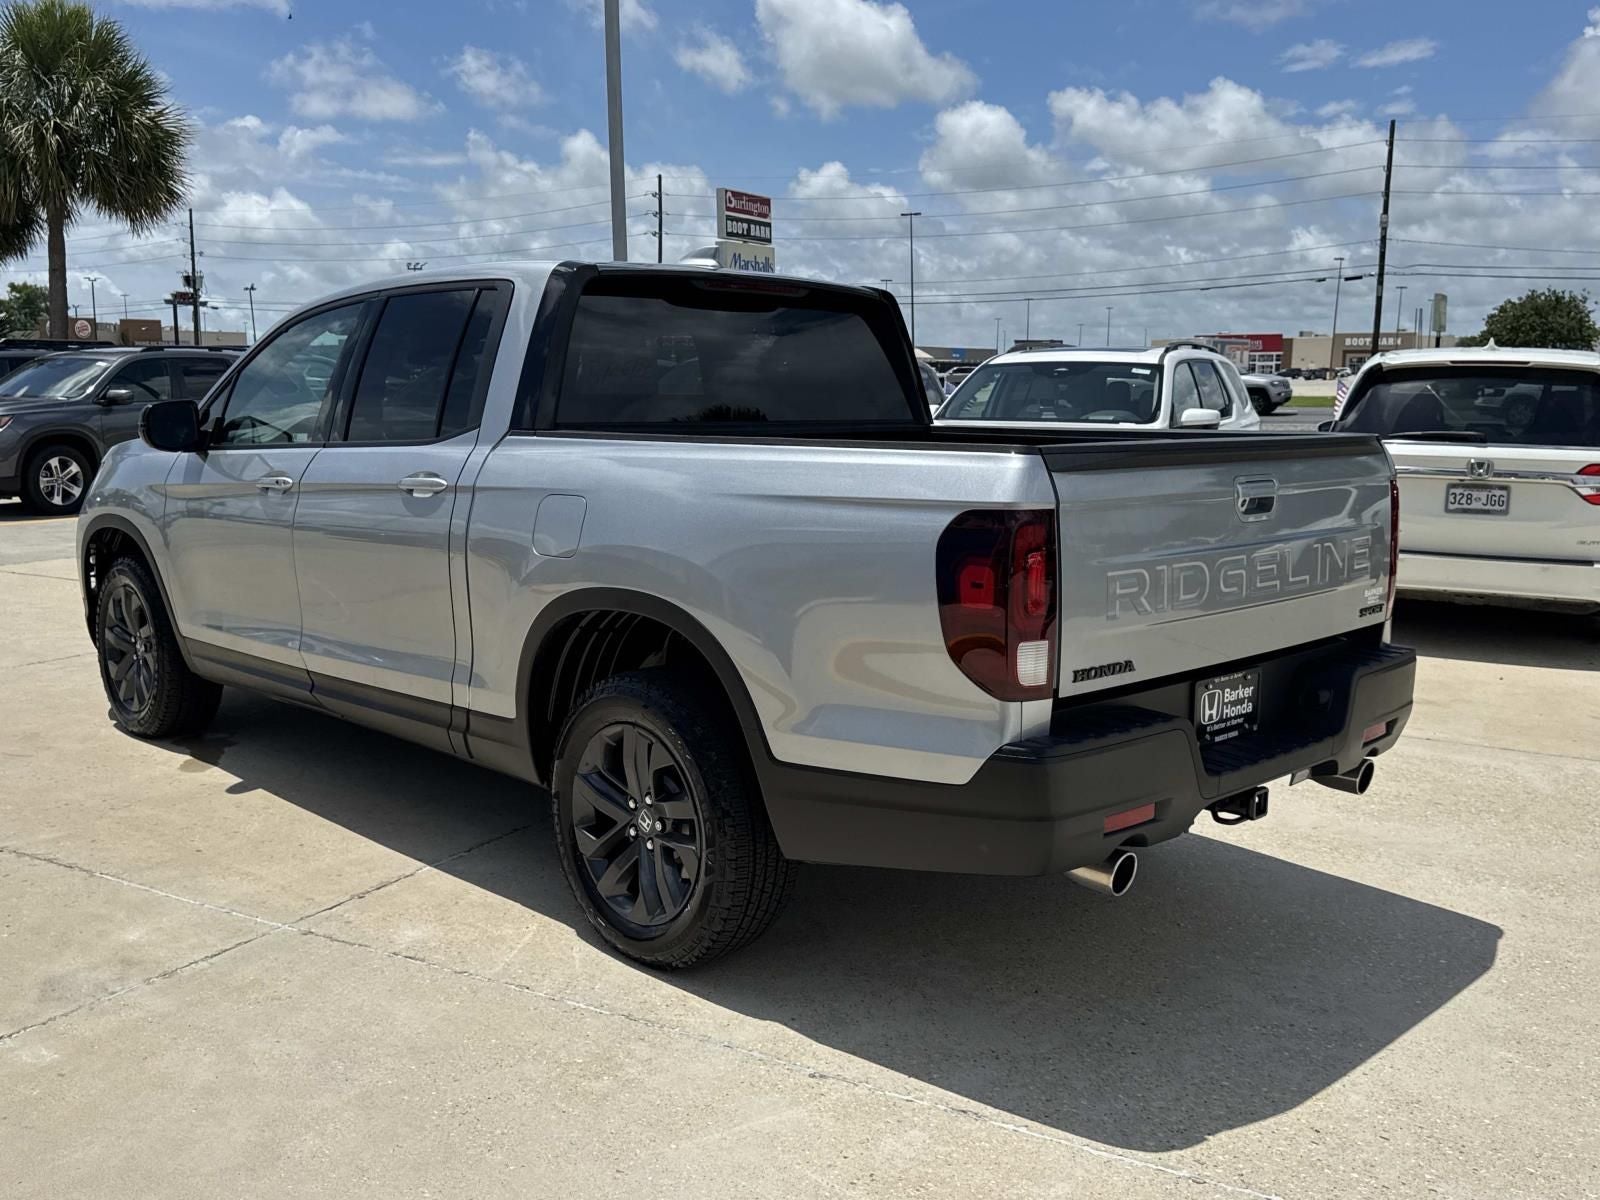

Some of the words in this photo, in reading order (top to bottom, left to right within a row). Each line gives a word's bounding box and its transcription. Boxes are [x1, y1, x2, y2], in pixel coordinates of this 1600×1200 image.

[726, 191, 770, 216] Burlington
[727, 220, 749, 235] BOOT
[750, 223, 771, 239] BARN
[729, 252, 775, 274] Marshalls
[1345, 337, 1372, 346] BOOT
[1450, 492, 1473, 506] 328
[1481, 493, 1505, 507] JGG
[1106, 535, 1372, 621] RIDGELINE
[1359, 603, 1385, 618] SPORT
[1072, 660, 1136, 683] HONDA
[1224, 684, 1254, 702] Barker
[1223, 699, 1253, 719] Honda
